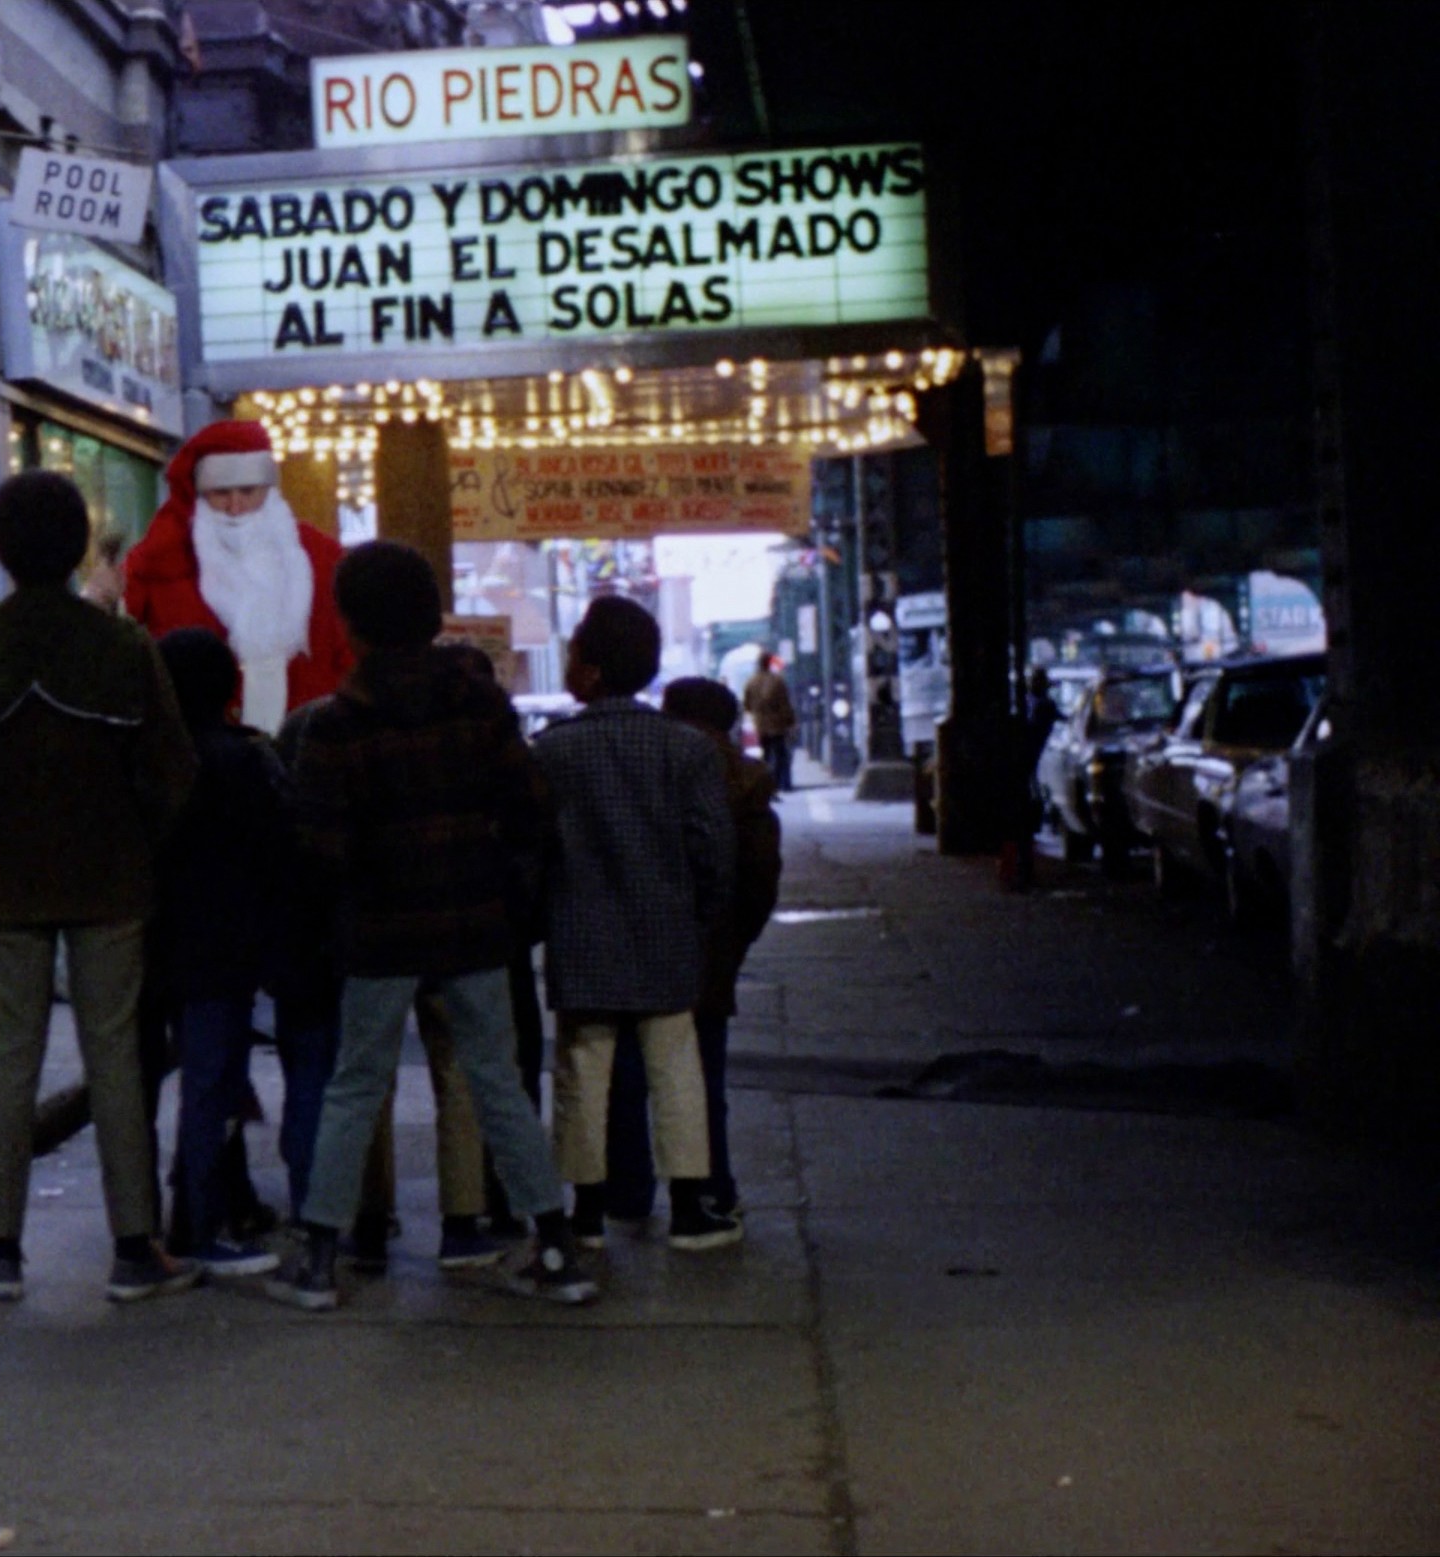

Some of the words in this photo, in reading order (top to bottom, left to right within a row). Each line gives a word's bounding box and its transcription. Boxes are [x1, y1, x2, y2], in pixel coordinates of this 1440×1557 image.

[324, 72, 416, 134] RIO
[442, 55, 683, 126] PIEDRAS
[35, 190, 122, 228] ROOM
[44, 160, 122, 198] POOL
[199, 186, 415, 243] SABADO
[432, 179, 467, 227] Y
[478, 164, 722, 225] DOMINGO
[734, 145, 926, 208] SHOWS
[263, 241, 412, 293] JUAN
[451, 233, 516, 281] EL
[538, 208, 883, 276] DESALMADO
[275, 302, 344, 351] AL
[372, 292, 455, 343] FIN
[483, 289, 522, 335] A
[548, 276, 733, 330] SOLAS
